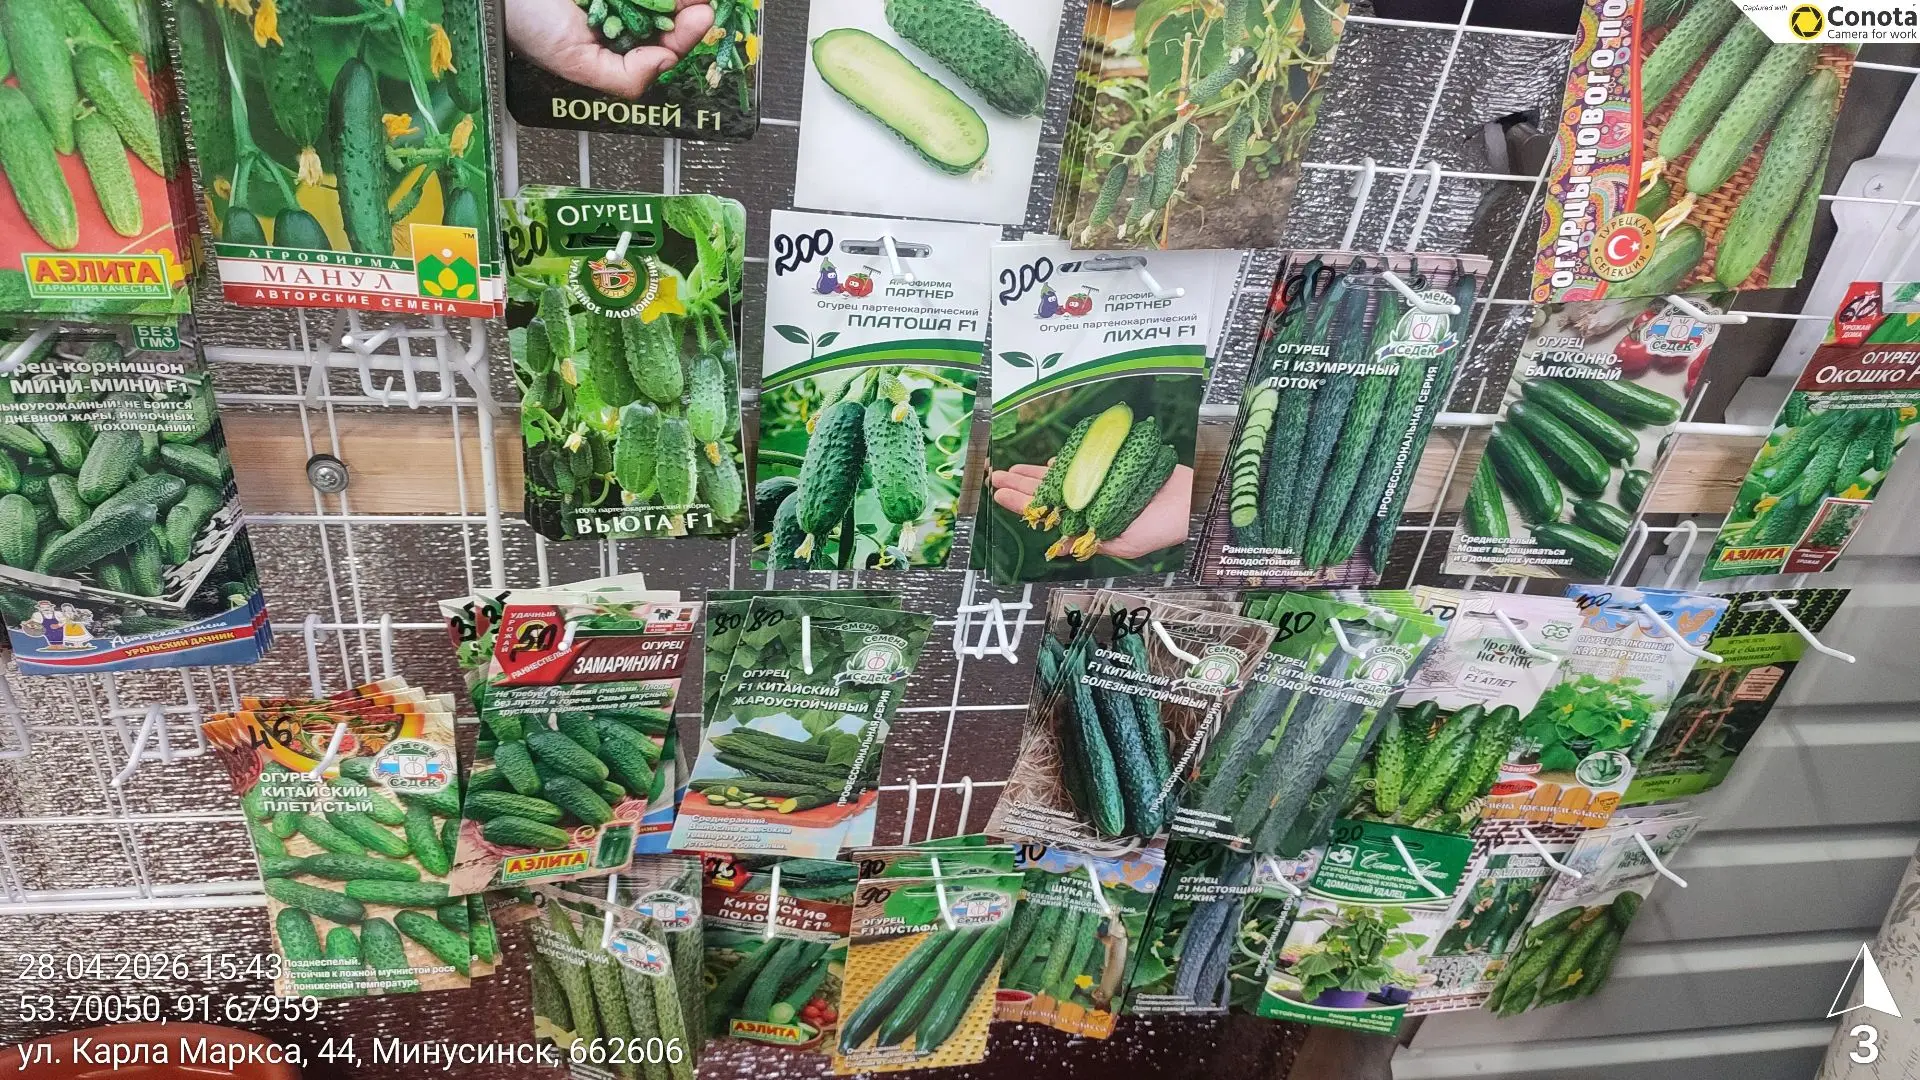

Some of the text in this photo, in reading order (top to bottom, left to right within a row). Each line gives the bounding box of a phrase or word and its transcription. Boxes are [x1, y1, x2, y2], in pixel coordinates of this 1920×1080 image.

[552, 97, 721, 131] ВОРОБЕЙ F1
[1551, 50, 1615, 288] ОГУРЦЫ НОВОГО
[557, 203, 653, 226] ОГУРЕЦ
[1598, 216, 1652, 240] ТУРЕЦКАЯ
[247, 248, 401, 270] АГРОФИРМА
[774, 228, 833, 276] 200
[36, 260, 154, 284] АЭЛИТА
[1594, 255, 1646, 279] СЕЛЕКЦИЯ
[263, 264, 394, 291] МАНУЛ
[999, 256, 1053, 306] 200
[38, 284, 162, 293] ГАРАНТИЯ КАЧЕСТВА
[568, 259, 602, 316] УРАГАННОЕ
[886, 288, 954, 299] ПАРТНЕР
[255, 289, 457, 313] АВТОРСКИЕ СЕМЕНА
[817, 301, 979, 316] Огурец партенокарпический
[1104, 299, 1172, 313] ПАРТНЕР
[848, 315, 976, 332] ПЛАТОША F1
[1040, 313, 1198, 333] Огурец партенокарпический
[137, 326, 173, 337] БЕЗ
[1103, 325, 1196, 343] ЛИХАЧ F1
[1278, 344, 1330, 357] ОГУРЕЦ
[1536, 336, 1584, 350] ОГУРЕЦ
[1530, 351, 1623, 366] F1 ОКОННО-
[1862, 352, 1918, 365] ОГУРЕЦ
[1272, 360, 1400, 376] F1 ИЗУМРУДНЫЙ
[1525, 365, 1622, 381] БАЛКОННЫЙ
[10, 378, 188, 394] МИНИ-МИНИ F1
[125, 401, 193, 410] НЕ БОИТСЯ
[5, 414, 67, 425] ДНЕВНОЙ
[71, 413, 115, 422] ЖАРЫ,
[140, 413, 195, 422] НОЧНЫХ
[94, 423, 196, 433] ПОХОЛОДАНИЙ!
[1377, 366, 1438, 518] ПРОФЕССИОНАЛЬНАЯ СЕРИЯ
[576, 513, 713, 534] ВЬЮГА F1
[1222, 545, 1295, 555] Раннеспелый.
[1457, 544, 1565, 556] Может выращиваться
[1721, 548, 1786, 561] АЭЛИТА
[1219, 557, 1300, 566] Холодостойкий
[1576, 593, 1612, 610] 100
[510, 611, 557, 619] УДАЧНЫЙ
[1274, 611, 1316, 642] 80
[125, 631, 235, 657] УРАЛЬСКИЙ ДАЧНИК
[642, 640, 685, 652] ОГУРЕЦ
[864, 634, 909, 649] семена
[1577, 635, 1674, 651] ОГУРЕЦ БАЛКОННЫЙ
[1095, 649, 1135, 665] ОГУРЕЦ
[1208, 646, 1247, 661] семена
[1264, 652, 1308, 669] ОГУРЕЦ
[1374, 645, 1413, 662] семена
[1573, 646, 1652, 662] КВАРТИРНИК
[573, 651, 678, 674] ЗАМАРИНУЙ F1
[742, 669, 790, 680] ОГУРЕЦ
[1087, 662, 1170, 687] F1 КИТАЙСКИЙ
[1257, 662, 1345, 688] F1 КИТАЙСКИЙ
[1464, 673, 1517, 688] F1 АТЛЕТ
[737, 682, 840, 697] F1 КИТАЙСКИЙ
[1080, 674, 1208, 710] БОЛЕЗНЕУСТОЙЧИВЫЙ
[1252, 672, 1383, 708] ХОЛОДОУСТОЙЧИВЫЙ
[732, 696, 869, 713] ЖАРОУСТОЙЧИВЫЙ
[247, 716, 293, 750] 46
[837, 689, 892, 807] ПРОФЕССИОНАЛЬНАЯ СЕРИЯ
[1149, 702, 1223, 813] ПРОФЕССИОНАЛЬНАЯ СЕРИЯ
[259, 772, 324, 784] ОГУРЕЦ
[261, 785, 368, 798] КИТАЙСКИЙ
[263, 800, 373, 813] ПЛЕТИСТЫЙ
[508, 853, 586, 873] АЭЛИТА
[1180, 876, 1218, 885] ОГУРЕЦ
[1051, 885, 1083, 898] ЩУКА
[1192, 885, 1263, 894] НАСТОЯЩИЙ
[1324, 879, 1406, 899] ДОМАШНИЙ УДАЛЕЦ
[1173, 893, 1216, 902] МУЖИК
[862, 916, 906, 926] ОГУРЕЦ
[876, 923, 939, 935] МУСТАФА
[284, 958, 361, 968] Позднеспелый.
[537, 945, 586, 967] ВКУСНЫЙ
[338, 970, 376, 979] ложной
[378, 966, 430, 977] мучнистой
[431, 965, 455, 974] росе
[292, 981, 354, 991] пониженной
[733, 1022, 798, 1038] АЭЛИТА
